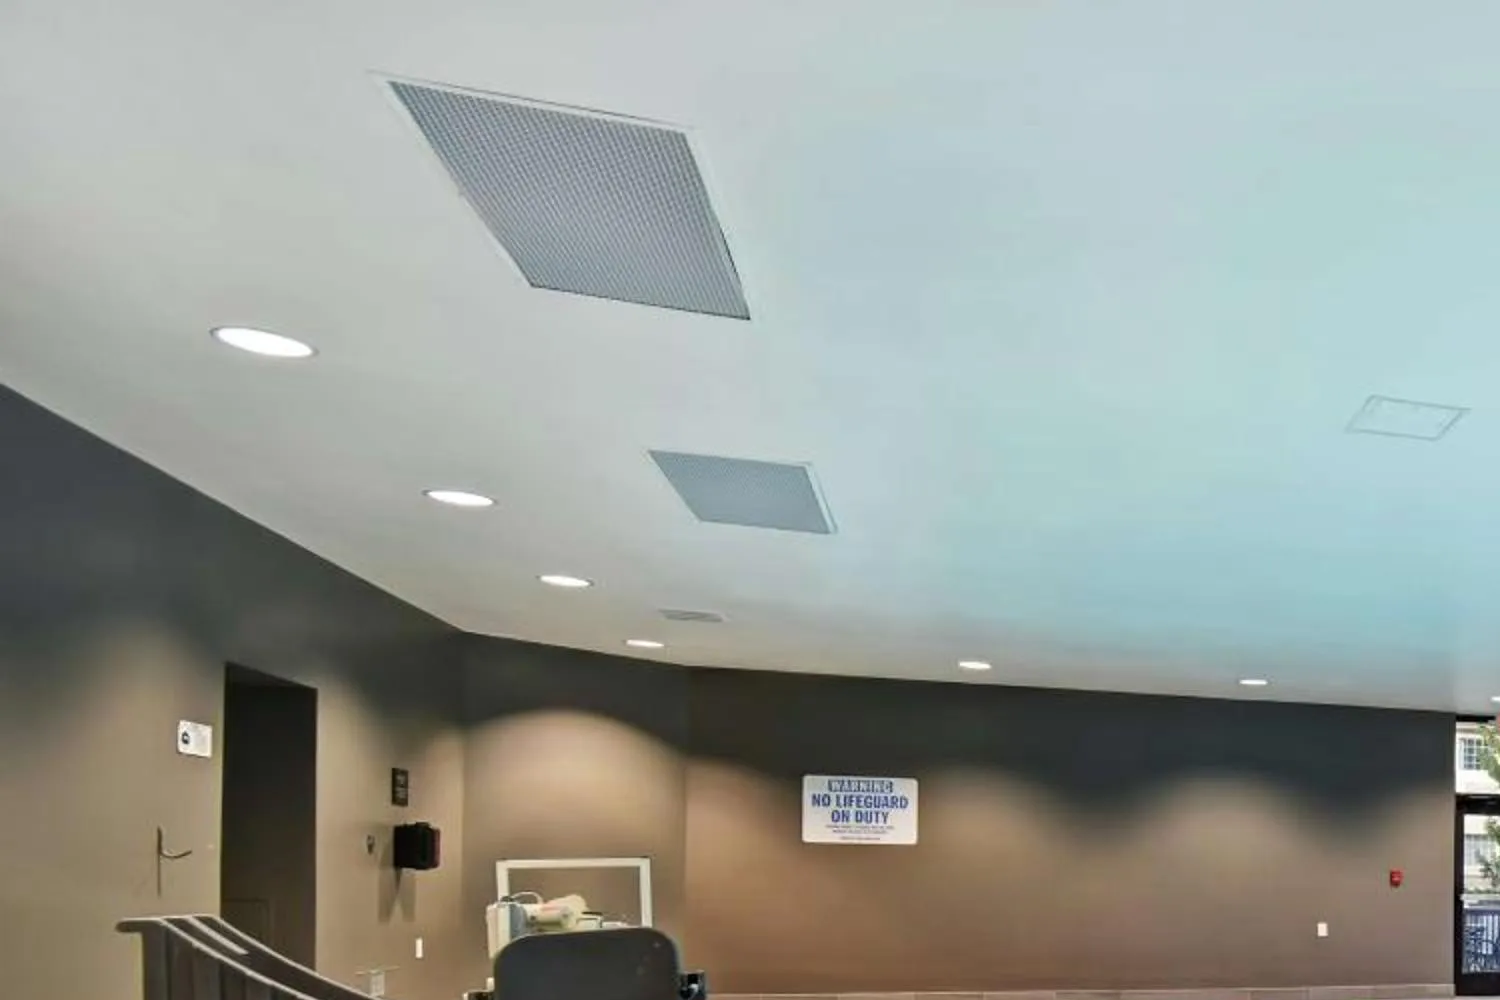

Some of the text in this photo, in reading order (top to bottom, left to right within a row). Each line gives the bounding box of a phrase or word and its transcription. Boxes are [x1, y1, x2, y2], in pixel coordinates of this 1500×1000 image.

[811, 793, 909, 809] NO LIFEGUARD
[831, 809, 889, 824] ON DUTY
